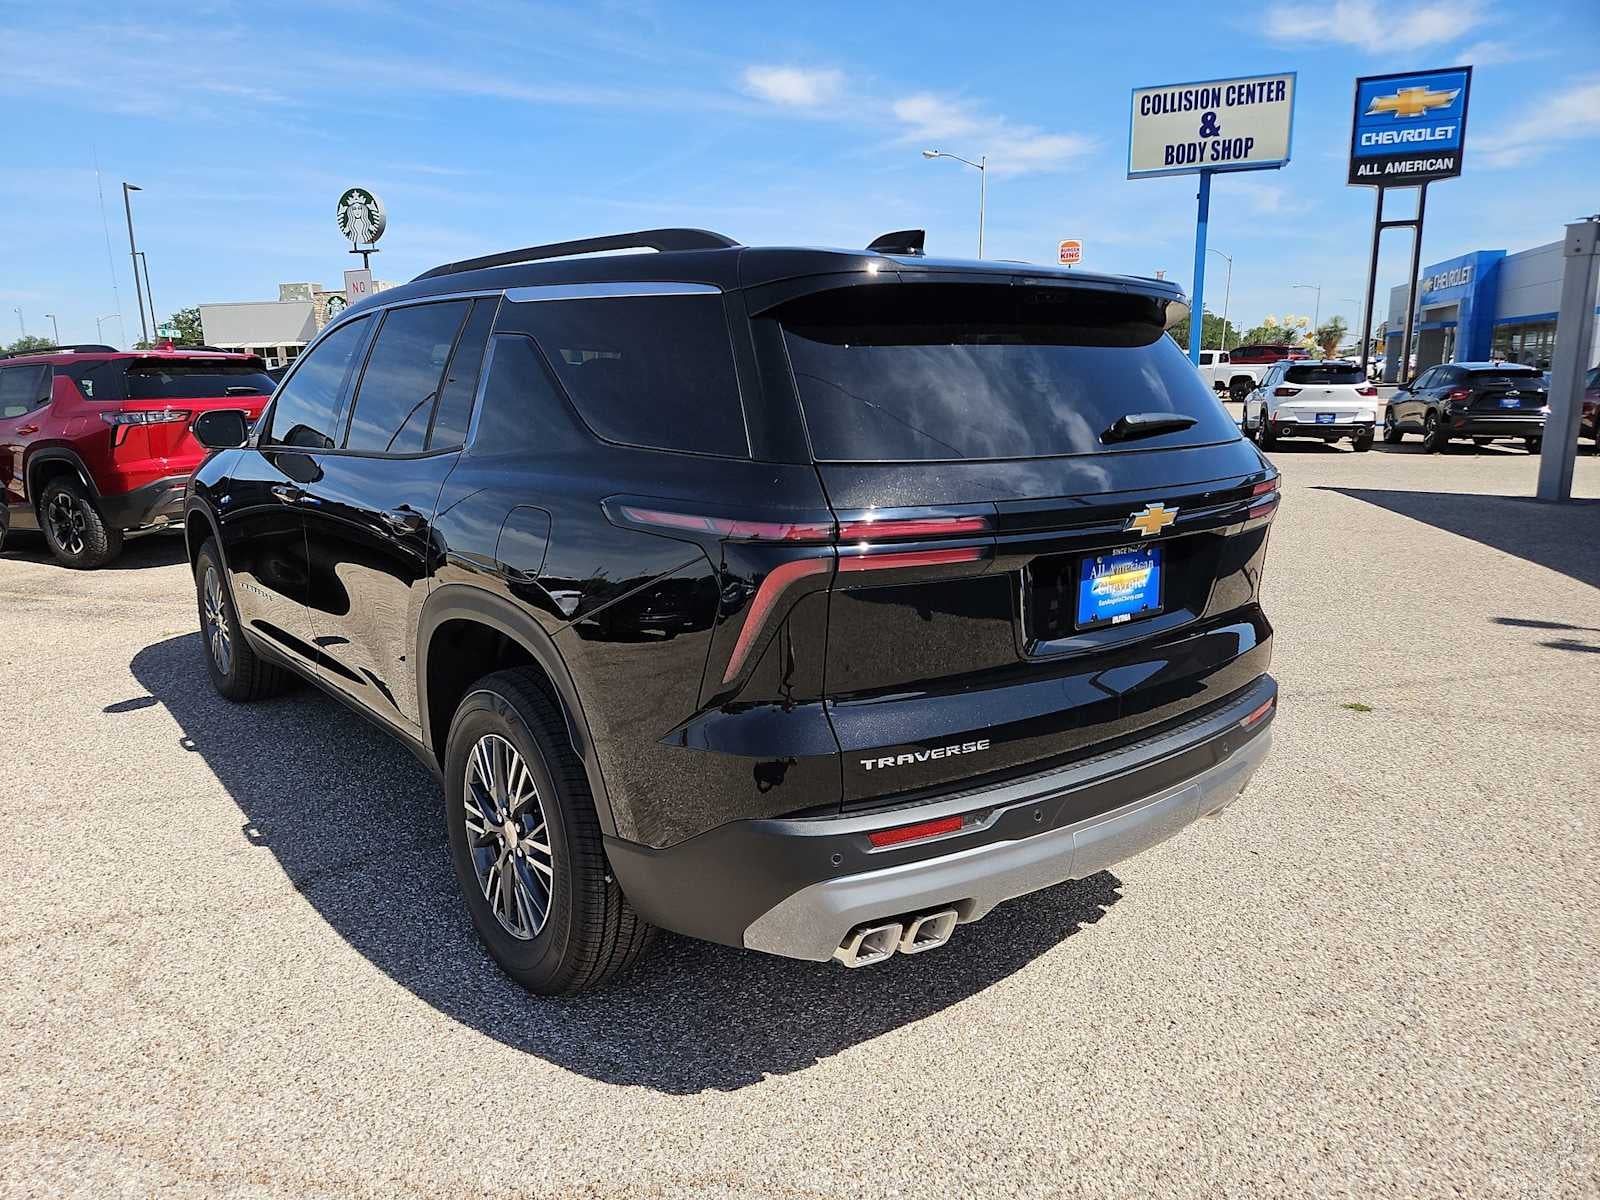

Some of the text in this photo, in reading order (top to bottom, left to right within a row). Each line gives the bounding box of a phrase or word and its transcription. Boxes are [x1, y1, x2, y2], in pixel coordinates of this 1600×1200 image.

[1140, 80, 1286, 116] COLLISION CENTER
[1199, 111, 1221, 139] &
[1361, 126, 1456, 146] CHEVROLET
[1164, 137, 1254, 165] BODY SHOP
[1357, 157, 1454, 176] ALL AMERICAN
[352, 281, 366, 293] NO
[1433, 265, 1473, 291] CHEVROLET
[1089, 564, 1106, 580] All
[860, 739, 990, 770] TRAVERSE
